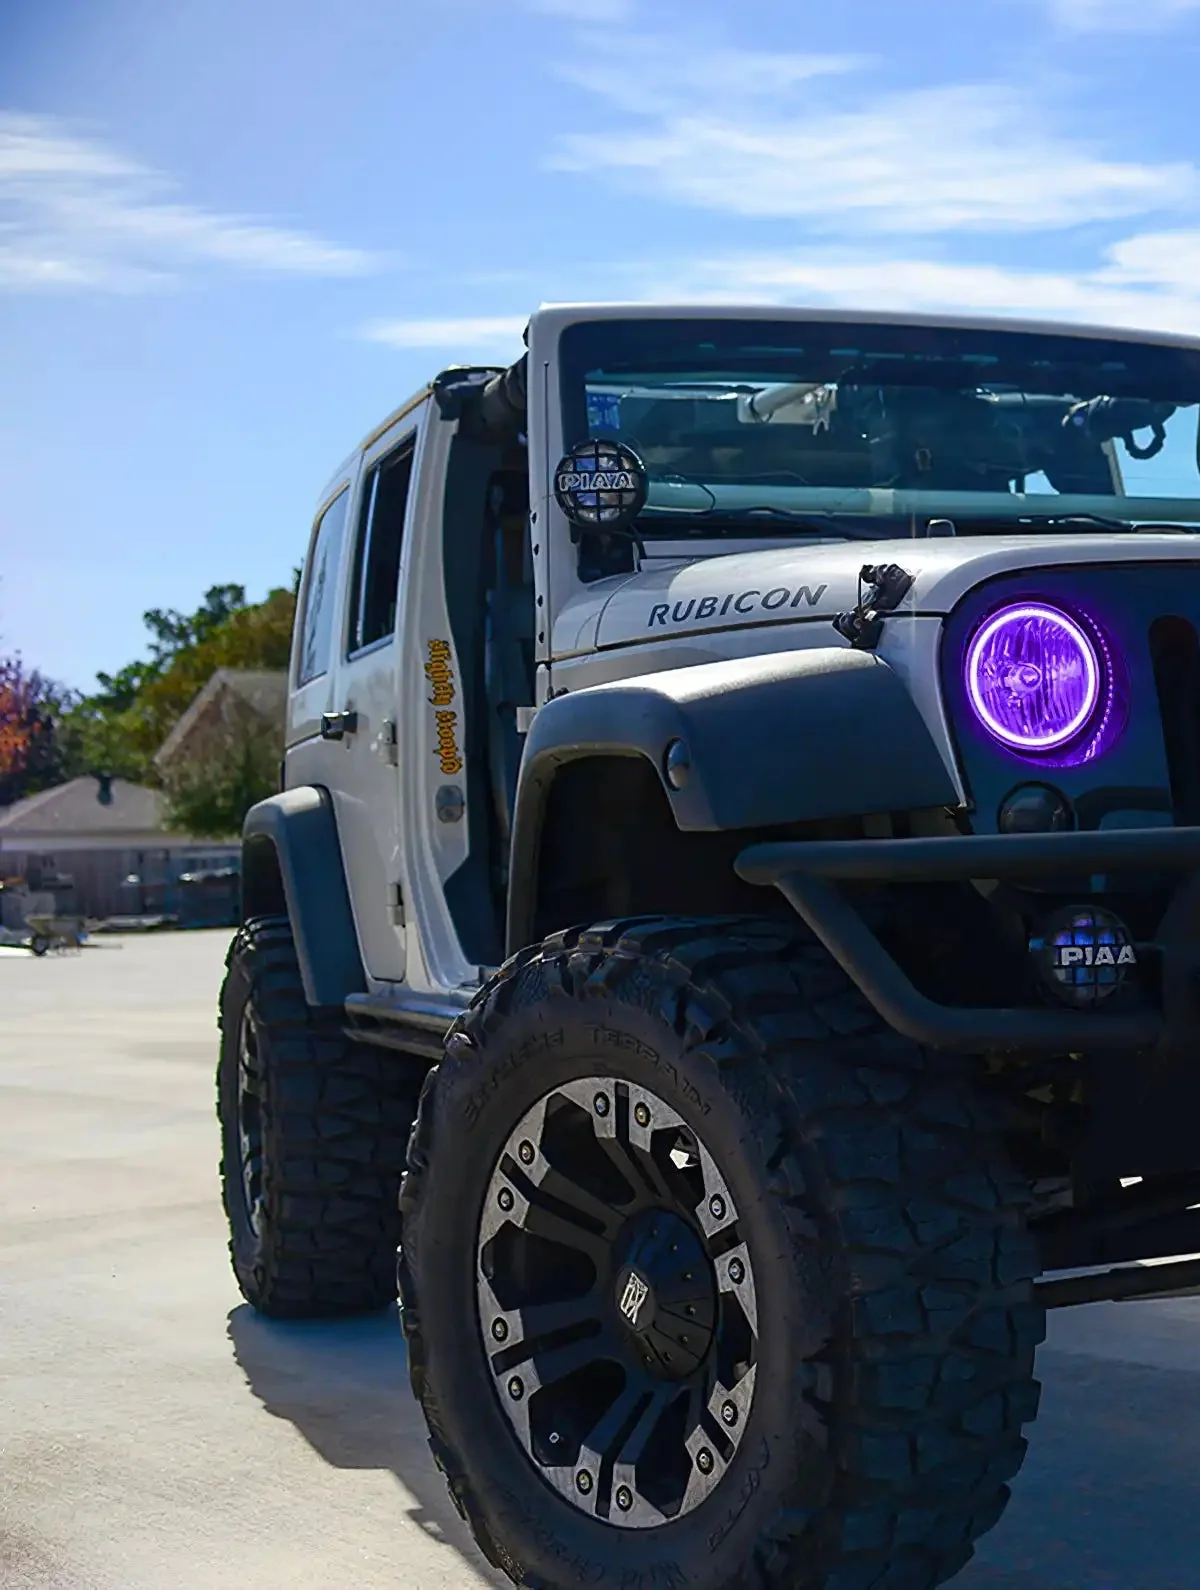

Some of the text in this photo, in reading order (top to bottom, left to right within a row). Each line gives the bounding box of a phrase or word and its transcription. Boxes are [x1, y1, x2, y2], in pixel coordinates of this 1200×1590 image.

[558, 471, 635, 492] PIAA
[647, 584, 828, 628] RUBICON
[1060, 944, 1137, 966] PIAA
